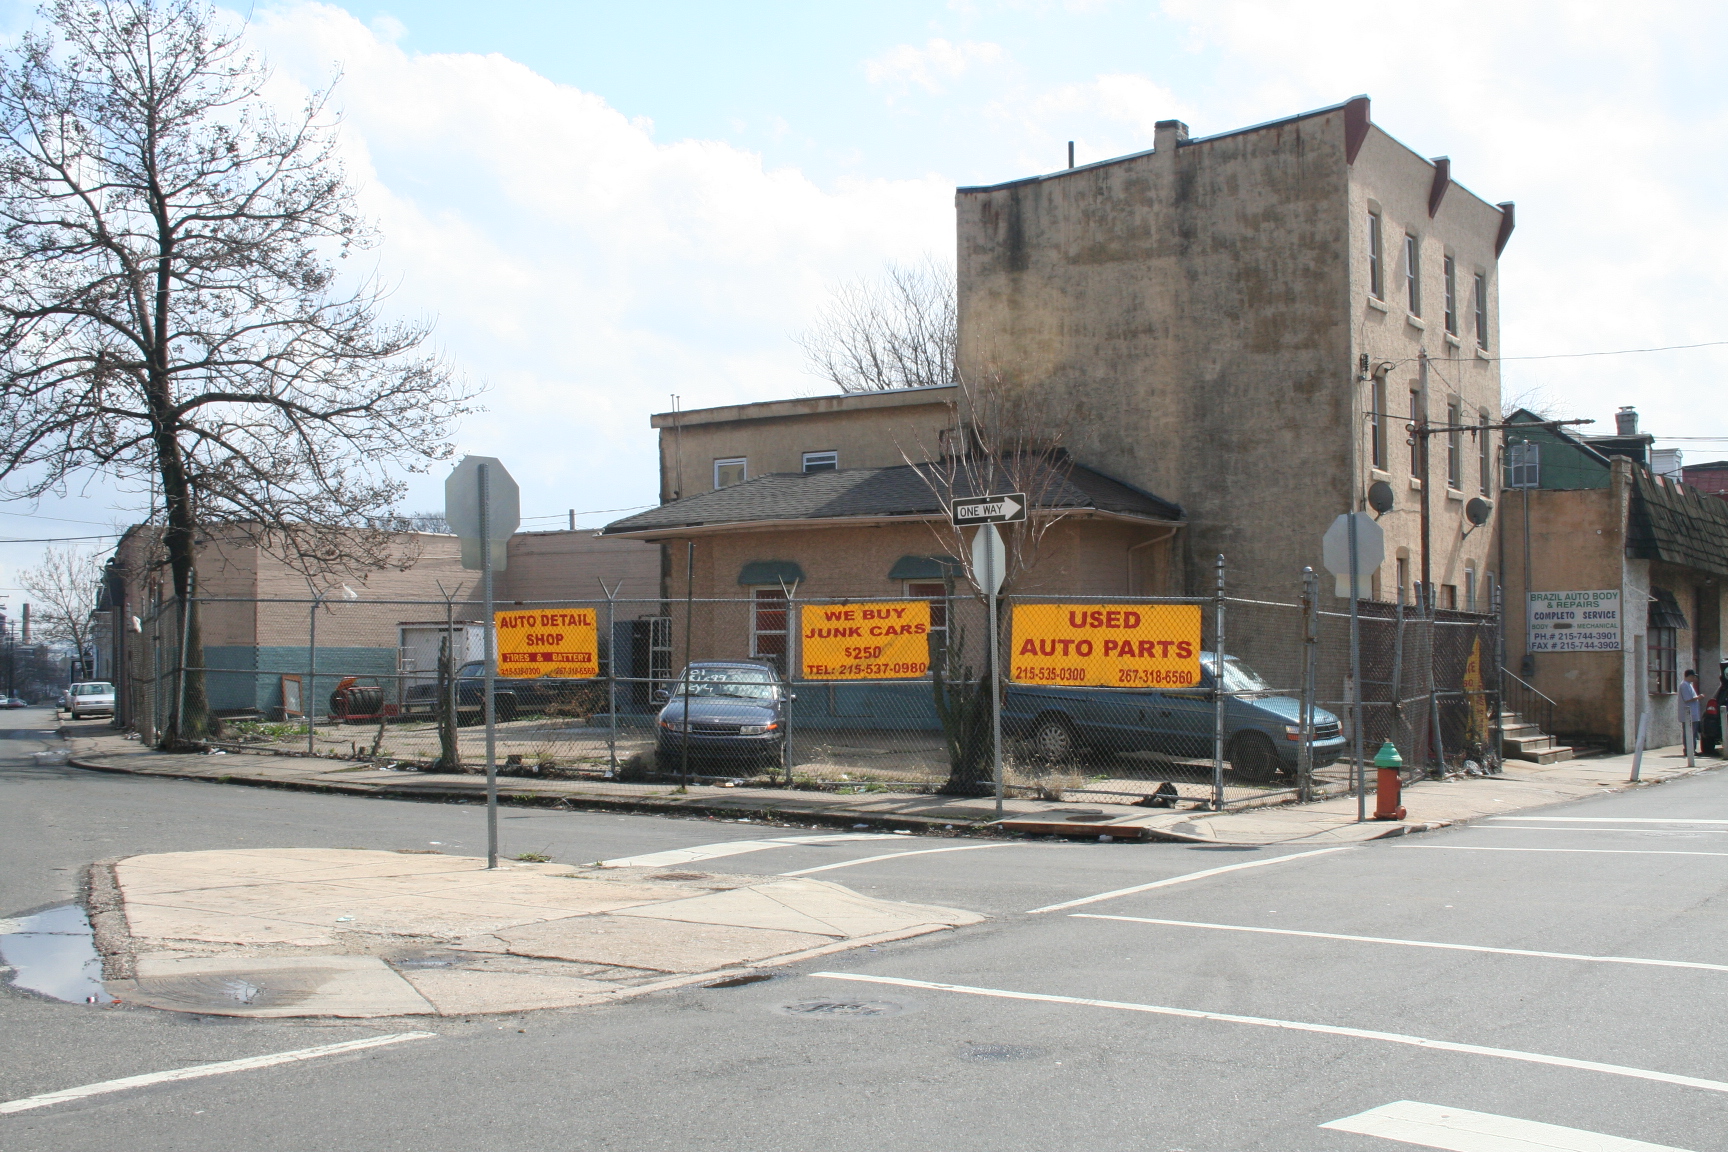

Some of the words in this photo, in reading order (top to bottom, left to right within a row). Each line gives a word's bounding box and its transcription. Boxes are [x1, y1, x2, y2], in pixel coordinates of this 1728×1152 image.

[960, 506, 979, 517] ONE
[983, 504, 1003, 515] WAY
[1530, 593, 1562, 601] BRAZIL
[1565, 592, 1590, 600] AUTO
[1592, 592, 1618, 600] BODY
[500, 615, 536, 629] AUTO
[541, 614, 591, 627] DETAIL
[824, 610, 855, 622] WE
[862, 608, 907, 620] BUY
[1069, 611, 1141, 629] USED
[1534, 611, 1575, 620] COMPLETO
[1582, 611, 1616, 619] SERVICE
[805, 627, 863, 639] JUNK
[869, 623, 927, 636] CARS
[1558, 632, 1617, 640] 215-744-3901
[526, 633, 564, 646] SHOP
[1532, 642, 1548, 650] FAX
[1560, 641, 1619, 649] 215-744-3902
[845, 646, 882, 660] $250
[1019, 639, 1093, 657] AUTO
[1104, 639, 1193, 659] PARTS
[506, 654, 530, 662] TIRES
[536, 654, 544, 662] &
[553, 653, 589, 662] BATTERY
[806, 665, 835, 675] TEL:
[839, 662, 927, 675] 215-537-0980
[1016, 666, 1086, 681] 215-535-0300
[1118, 669, 1193, 684] 267-318-6560
